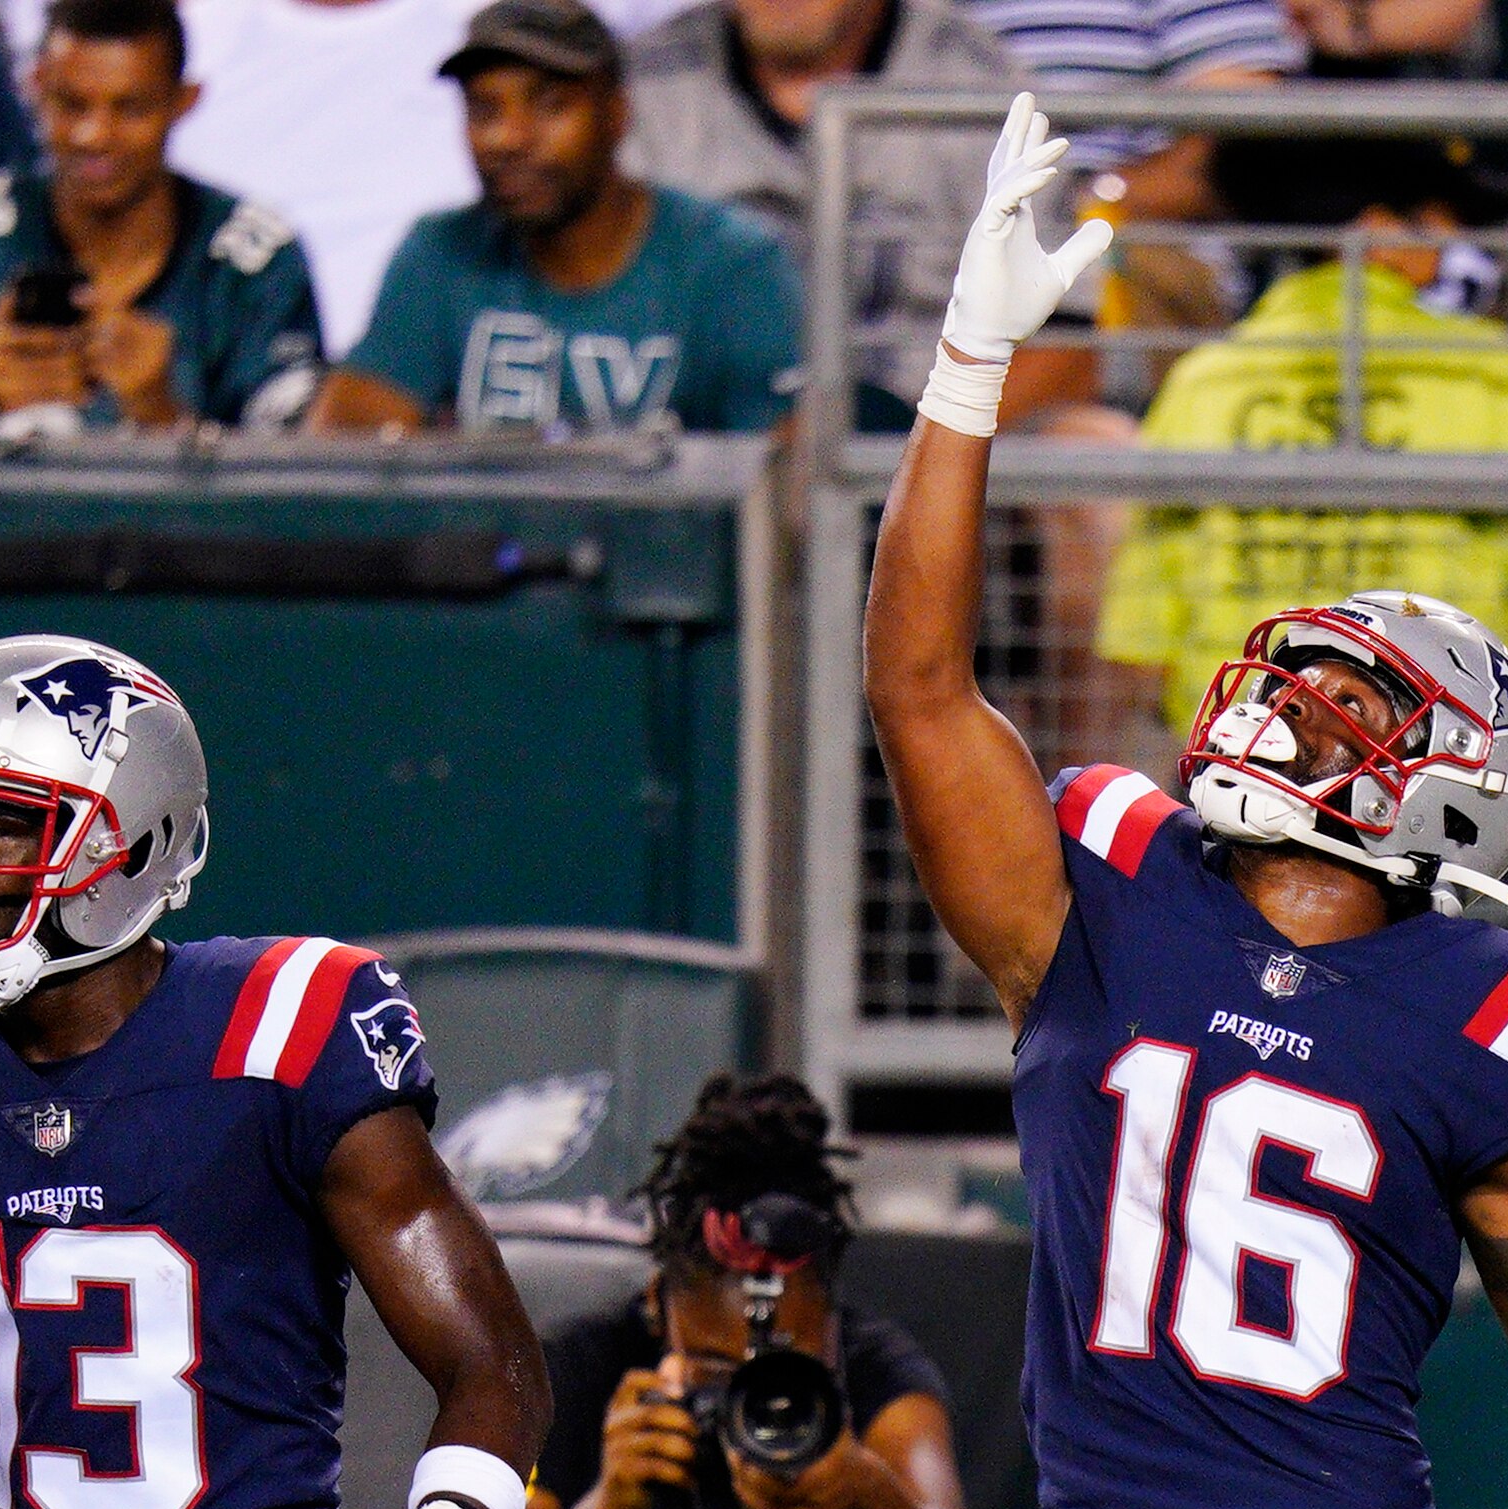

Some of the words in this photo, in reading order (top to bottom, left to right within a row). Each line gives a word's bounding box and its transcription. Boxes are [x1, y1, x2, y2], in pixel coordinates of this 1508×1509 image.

[1266, 970, 1295, 989] NFL
[1207, 1010, 1314, 1061] PATRIOTS
[38, 1127, 65, 1146] NFL
[6, 1185, 104, 1218] PATRIOTS
[1090, 1037, 1385, 1402] 16
